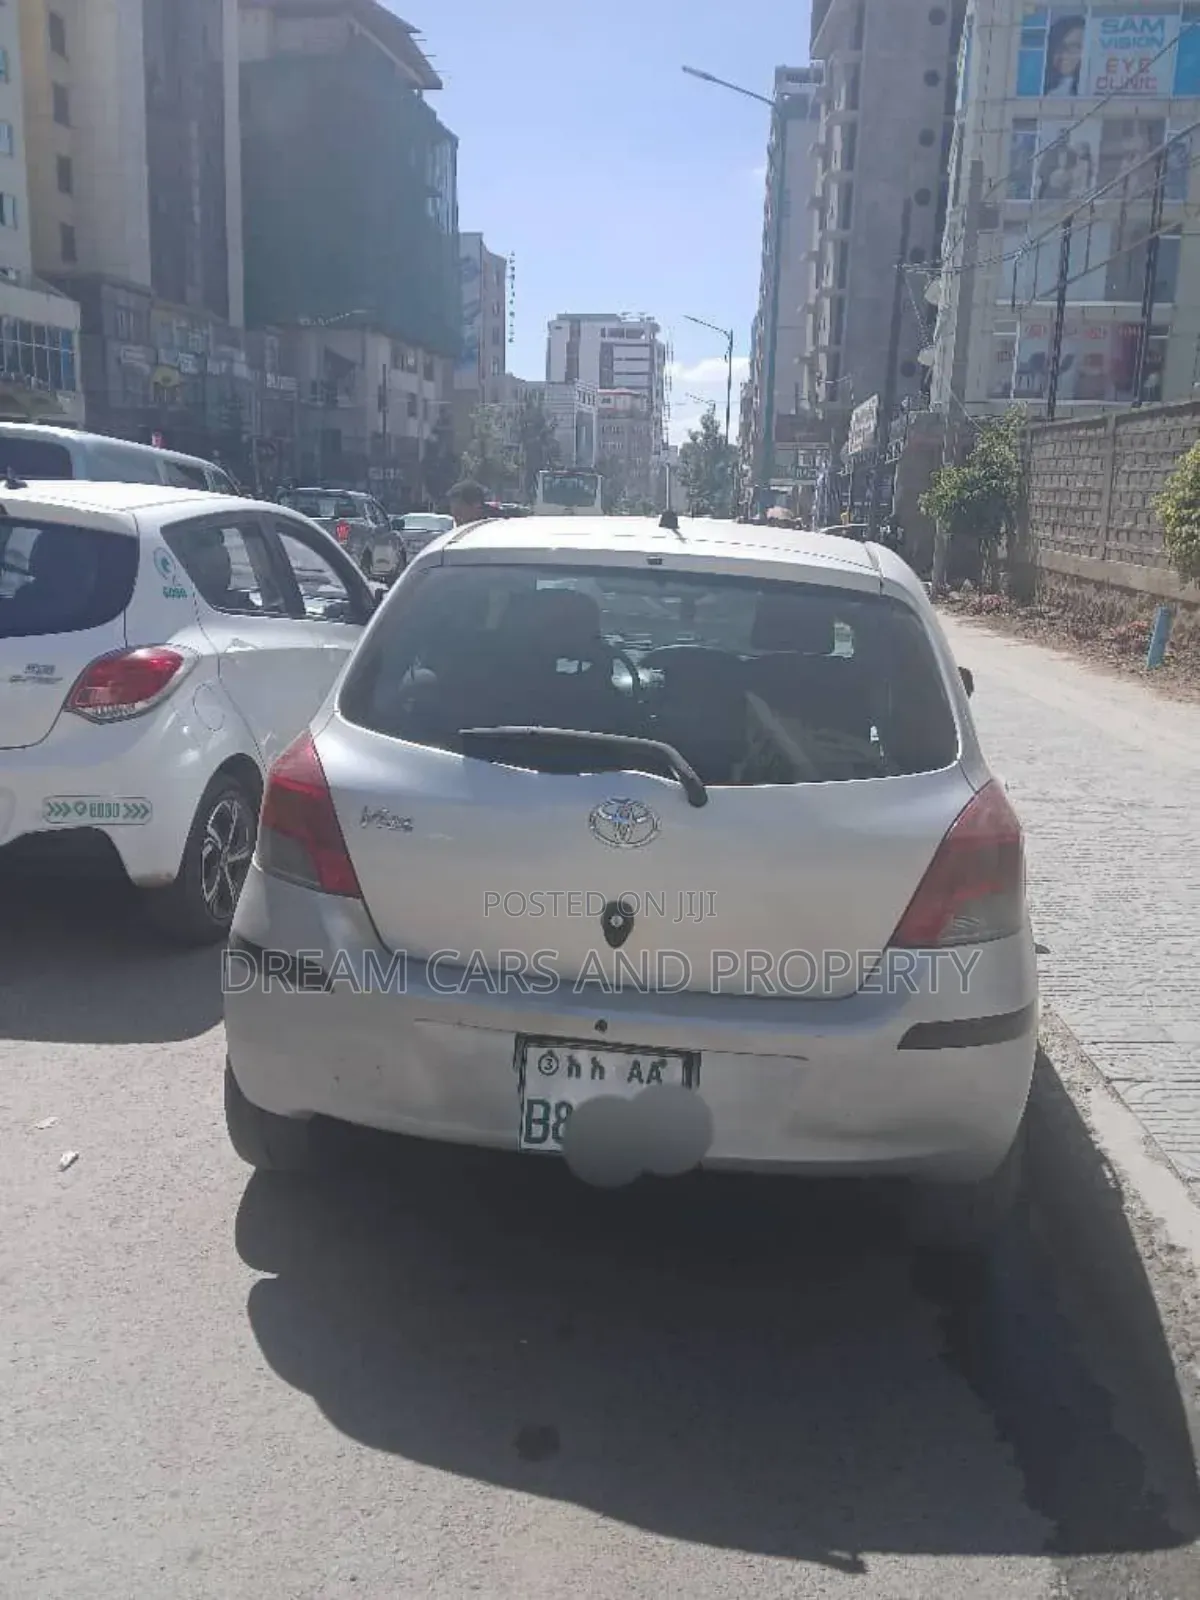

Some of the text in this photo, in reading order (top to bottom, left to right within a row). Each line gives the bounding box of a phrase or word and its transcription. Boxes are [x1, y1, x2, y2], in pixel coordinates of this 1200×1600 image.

[1101, 17, 1165, 35] SAM
[1101, 36, 1164, 49] VISION
[1105, 57, 1152, 74] EYE
[1095, 76, 1157, 90] CLINIC
[627, 1059, 664, 1084] AA
